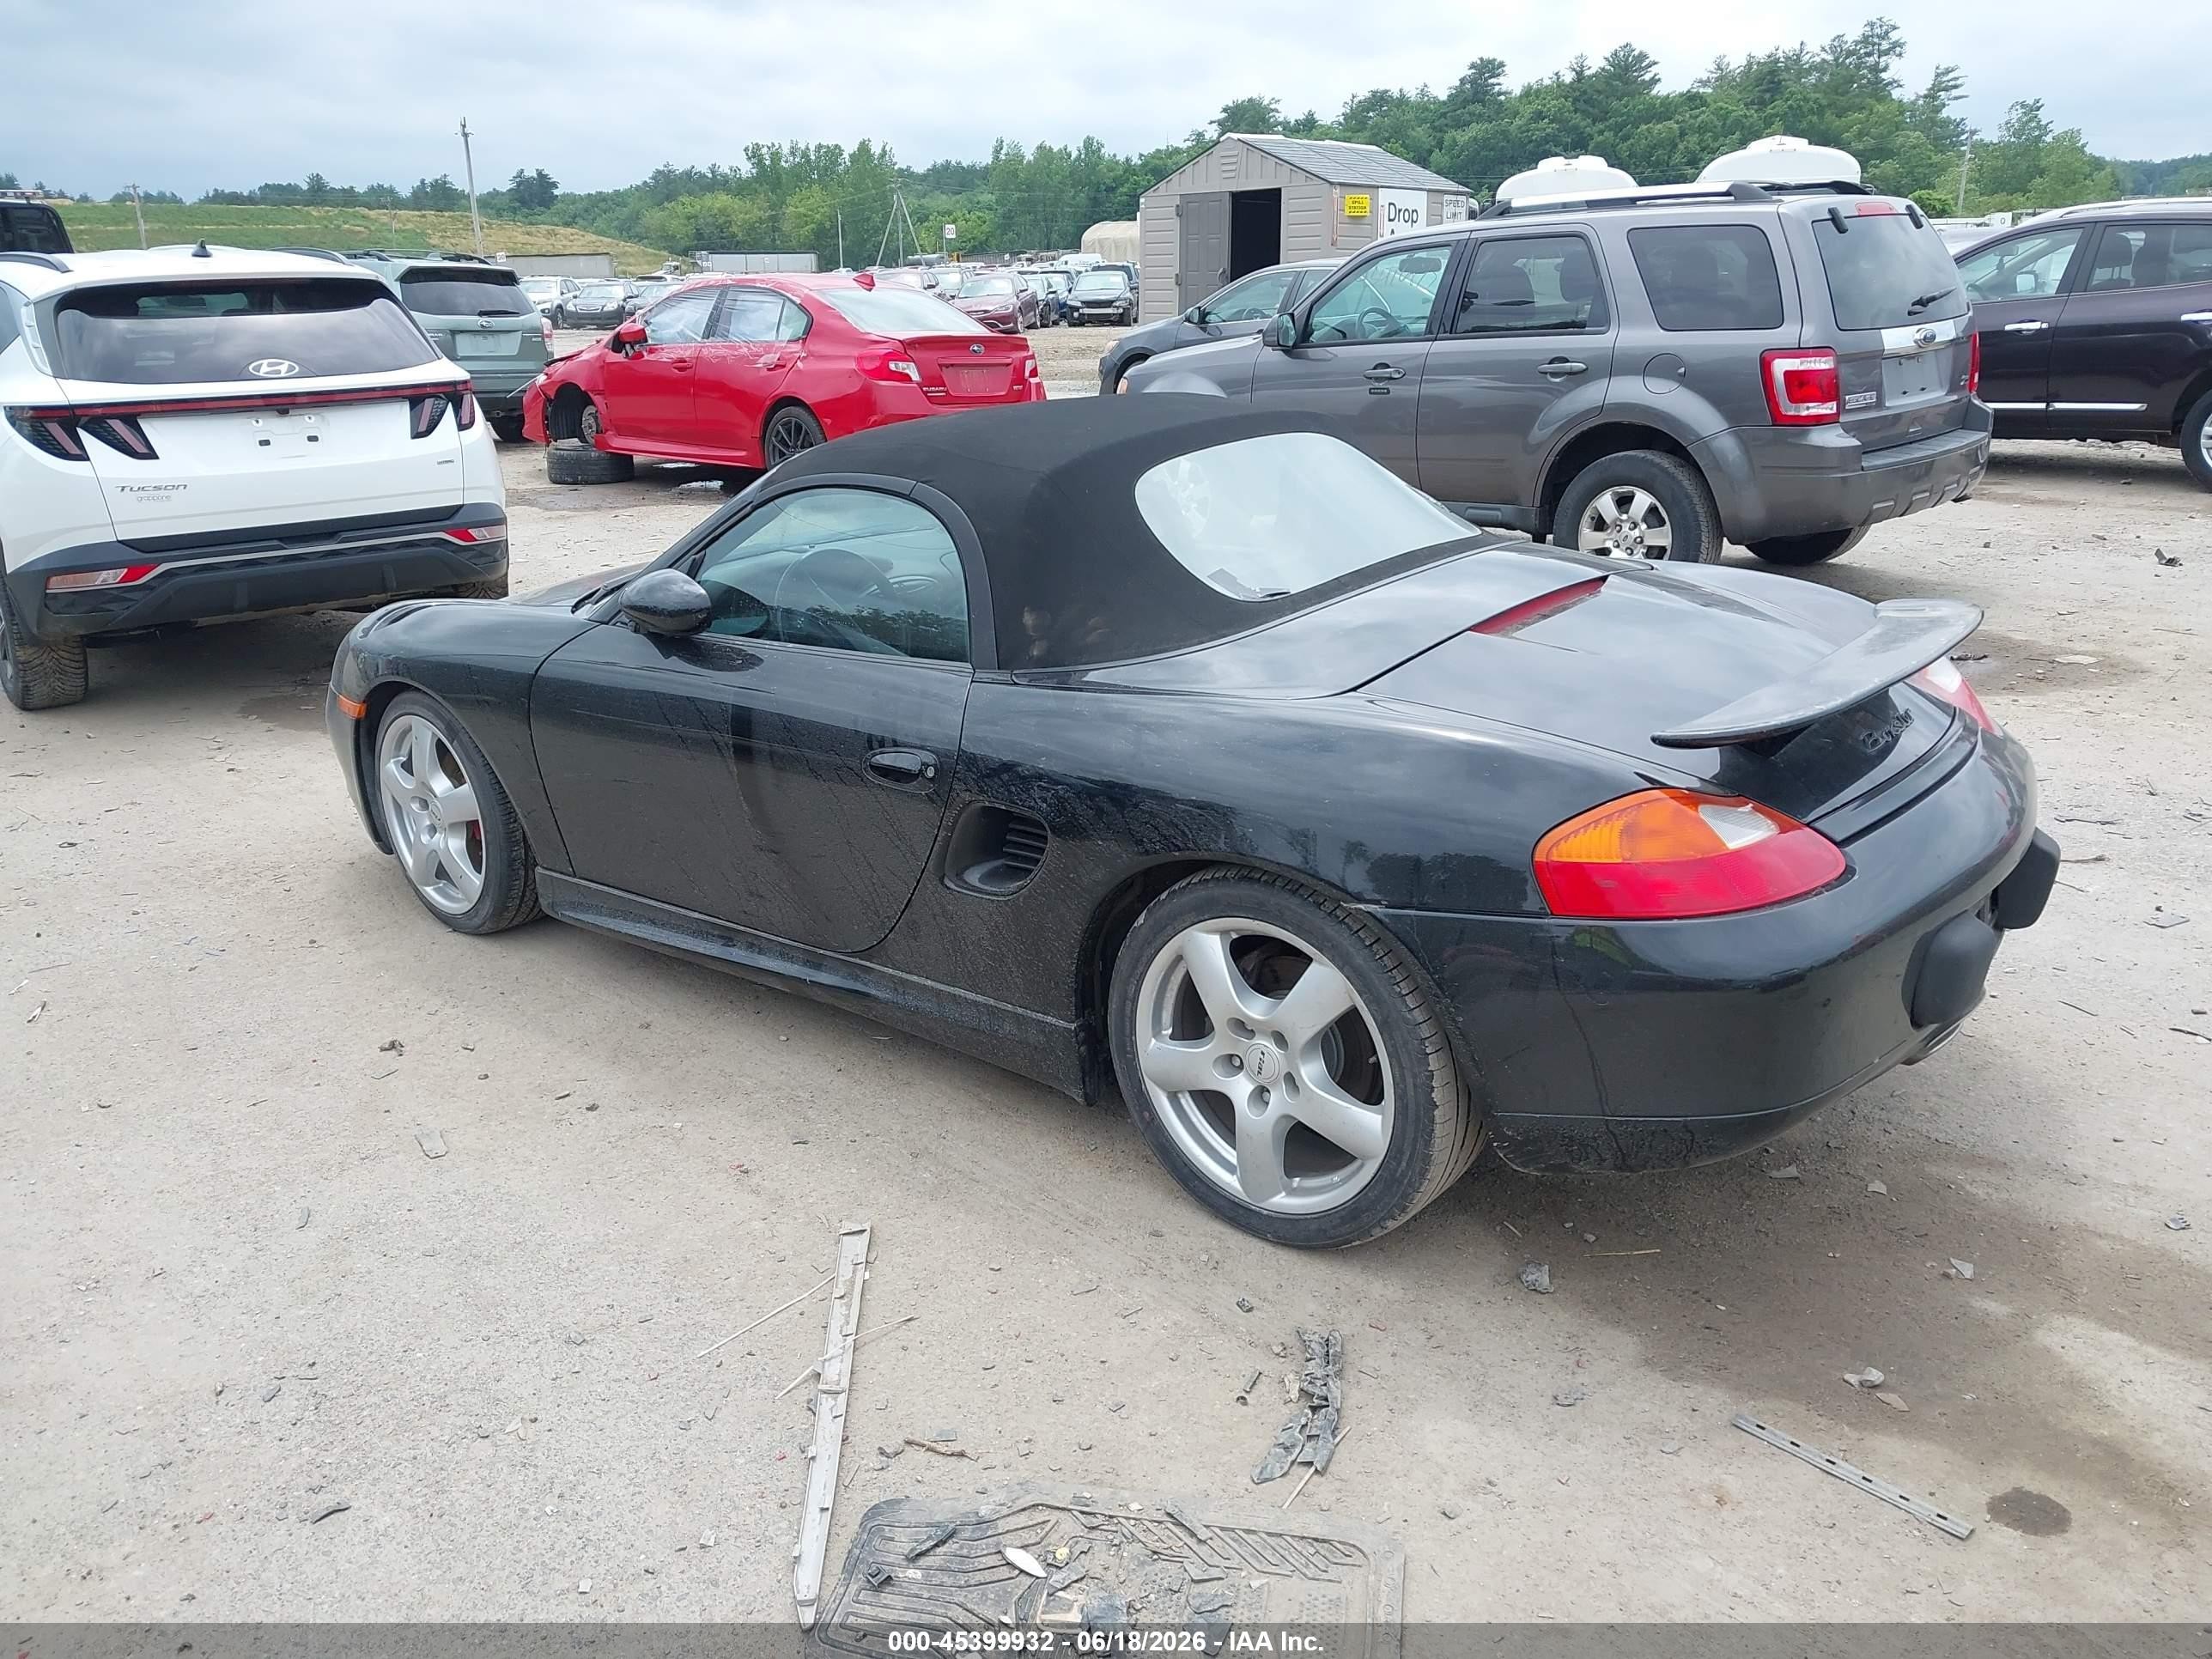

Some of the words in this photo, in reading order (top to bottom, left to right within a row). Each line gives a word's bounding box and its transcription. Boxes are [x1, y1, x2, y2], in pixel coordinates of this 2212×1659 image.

[1445, 199, 1465, 208] SPEED
[1388, 203, 1419, 228] Drop
[1446, 211, 1462, 220] LIMIT
[946, 227, 955, 235] 20
